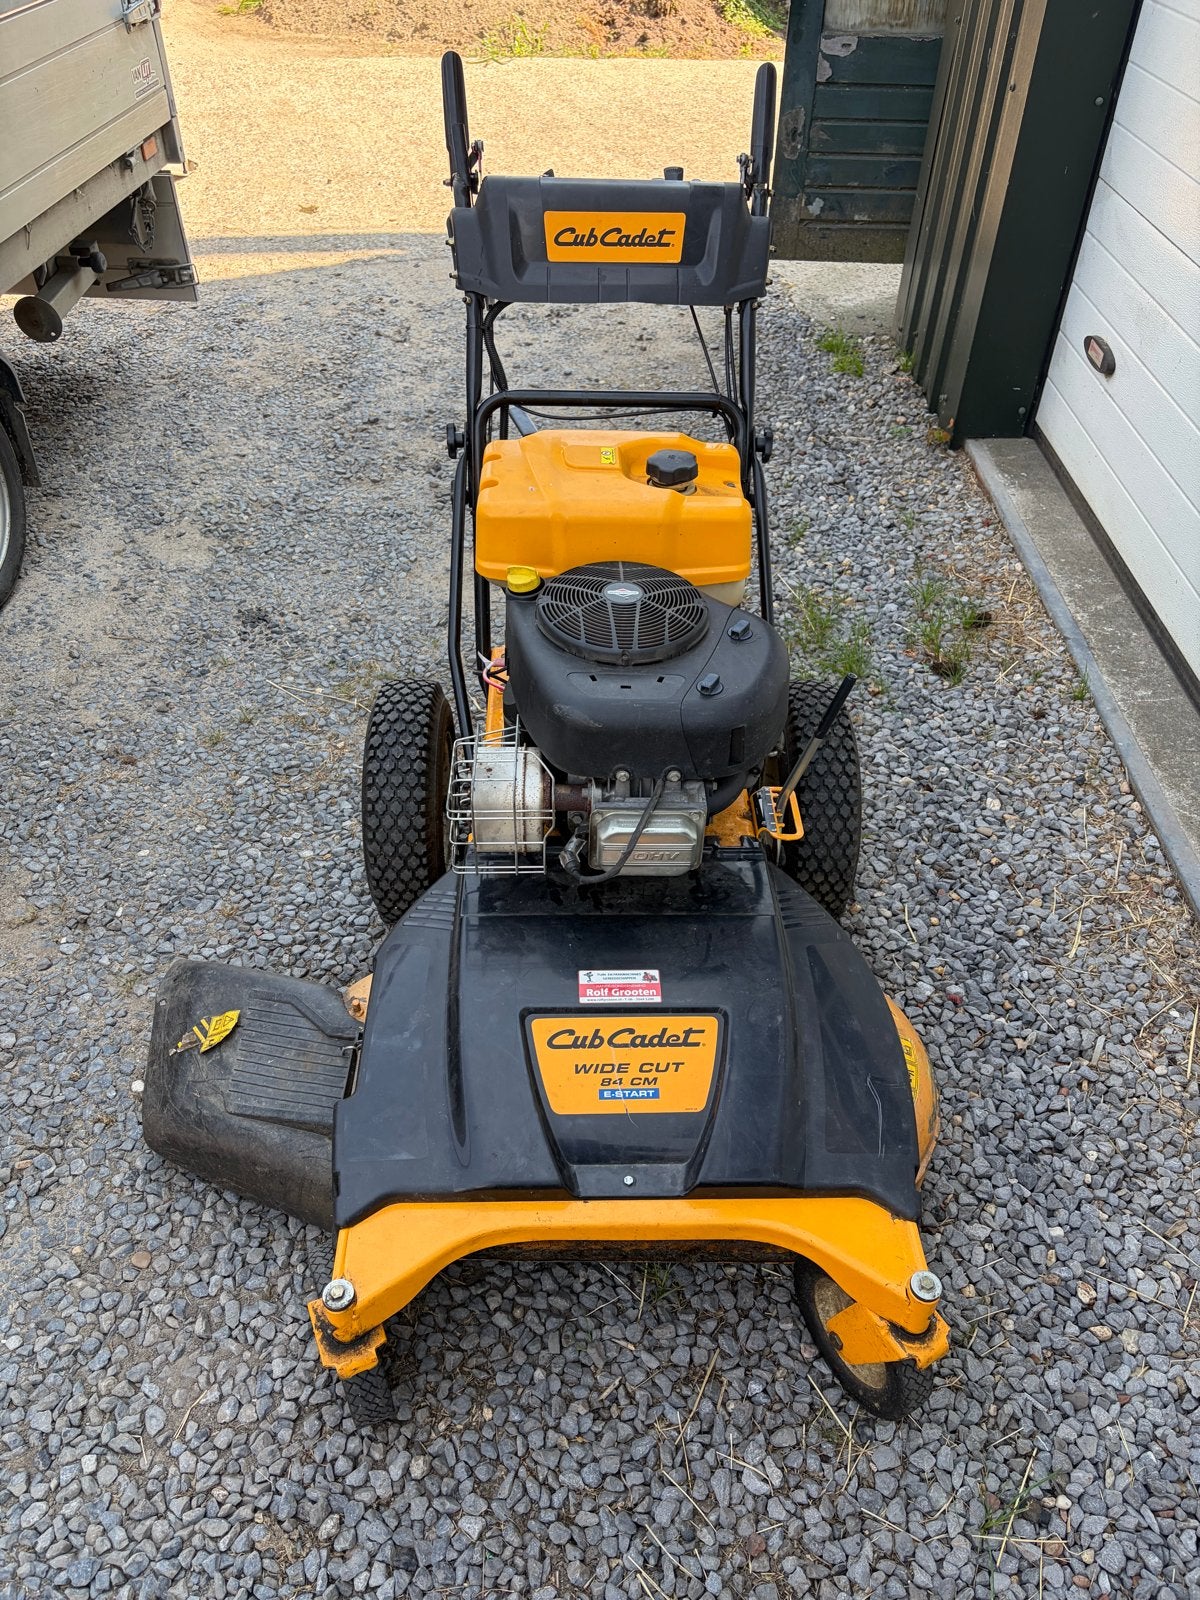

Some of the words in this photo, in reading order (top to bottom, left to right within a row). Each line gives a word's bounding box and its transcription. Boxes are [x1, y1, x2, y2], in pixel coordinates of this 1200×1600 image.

[553, 227, 599, 247] Cub
[600, 227, 676, 247] Cadet
[634, 851, 680, 861] OHV
[586, 988, 608, 997] Rolf
[611, 988, 657, 997] Grooten
[546, 1028, 604, 1050] Cub
[607, 1027, 706, 1049] Cadet
[574, 1063, 630, 1075] WIDE
[638, 1062, 685, 1073] CUT
[600, 1077, 623, 1087] 84
[630, 1077, 658, 1087] CM
[603, 1090, 655, 1098] E-START
